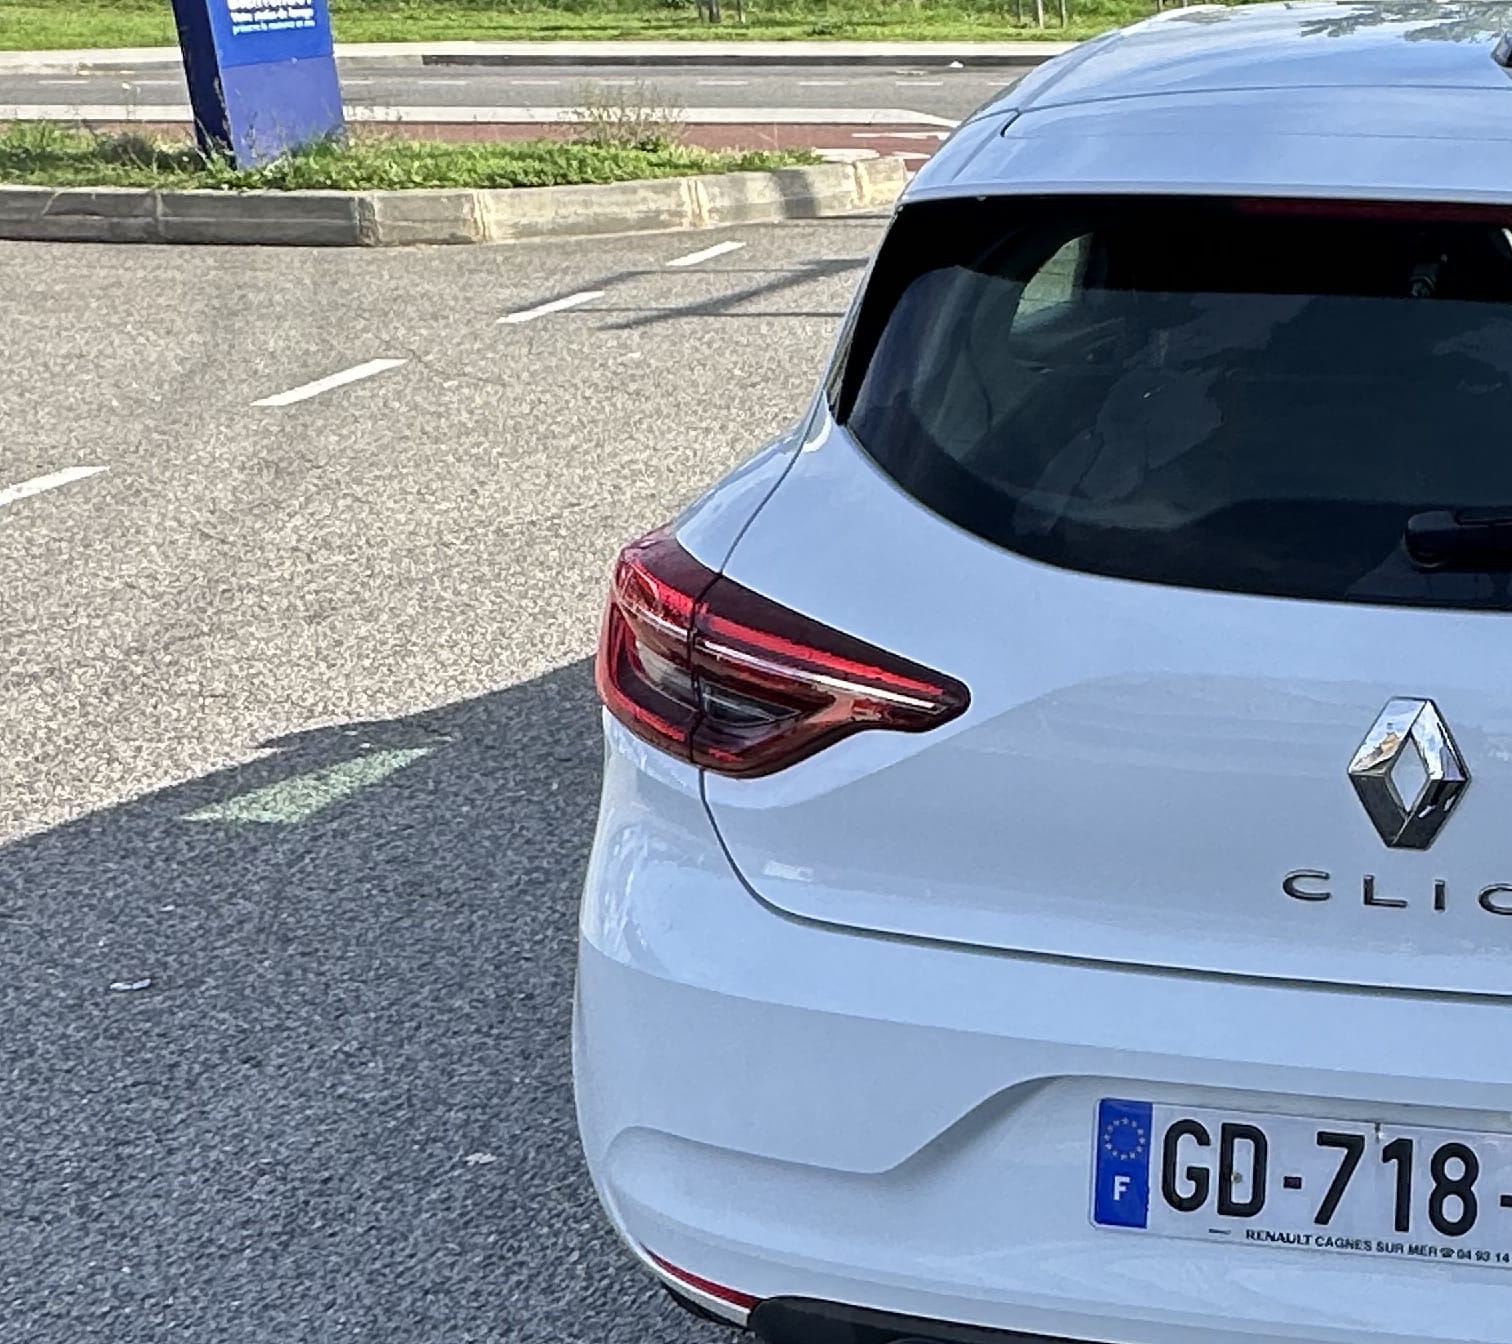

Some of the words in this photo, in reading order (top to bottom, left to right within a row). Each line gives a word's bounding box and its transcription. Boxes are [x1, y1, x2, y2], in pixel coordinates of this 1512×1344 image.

[1113, 1175, 1131, 1201] F
[1246, 1229, 1313, 1245] RENAULT
[1315, 1236, 1372, 1252] CAGNES
[1376, 1241, 1404, 1254] SUR
[1408, 1244, 1438, 1258] MER
[1456, 1248, 1472, 1260] 04
[1475, 1250, 1490, 1262] 93
[1495, 1252, 1510, 1264] 14
